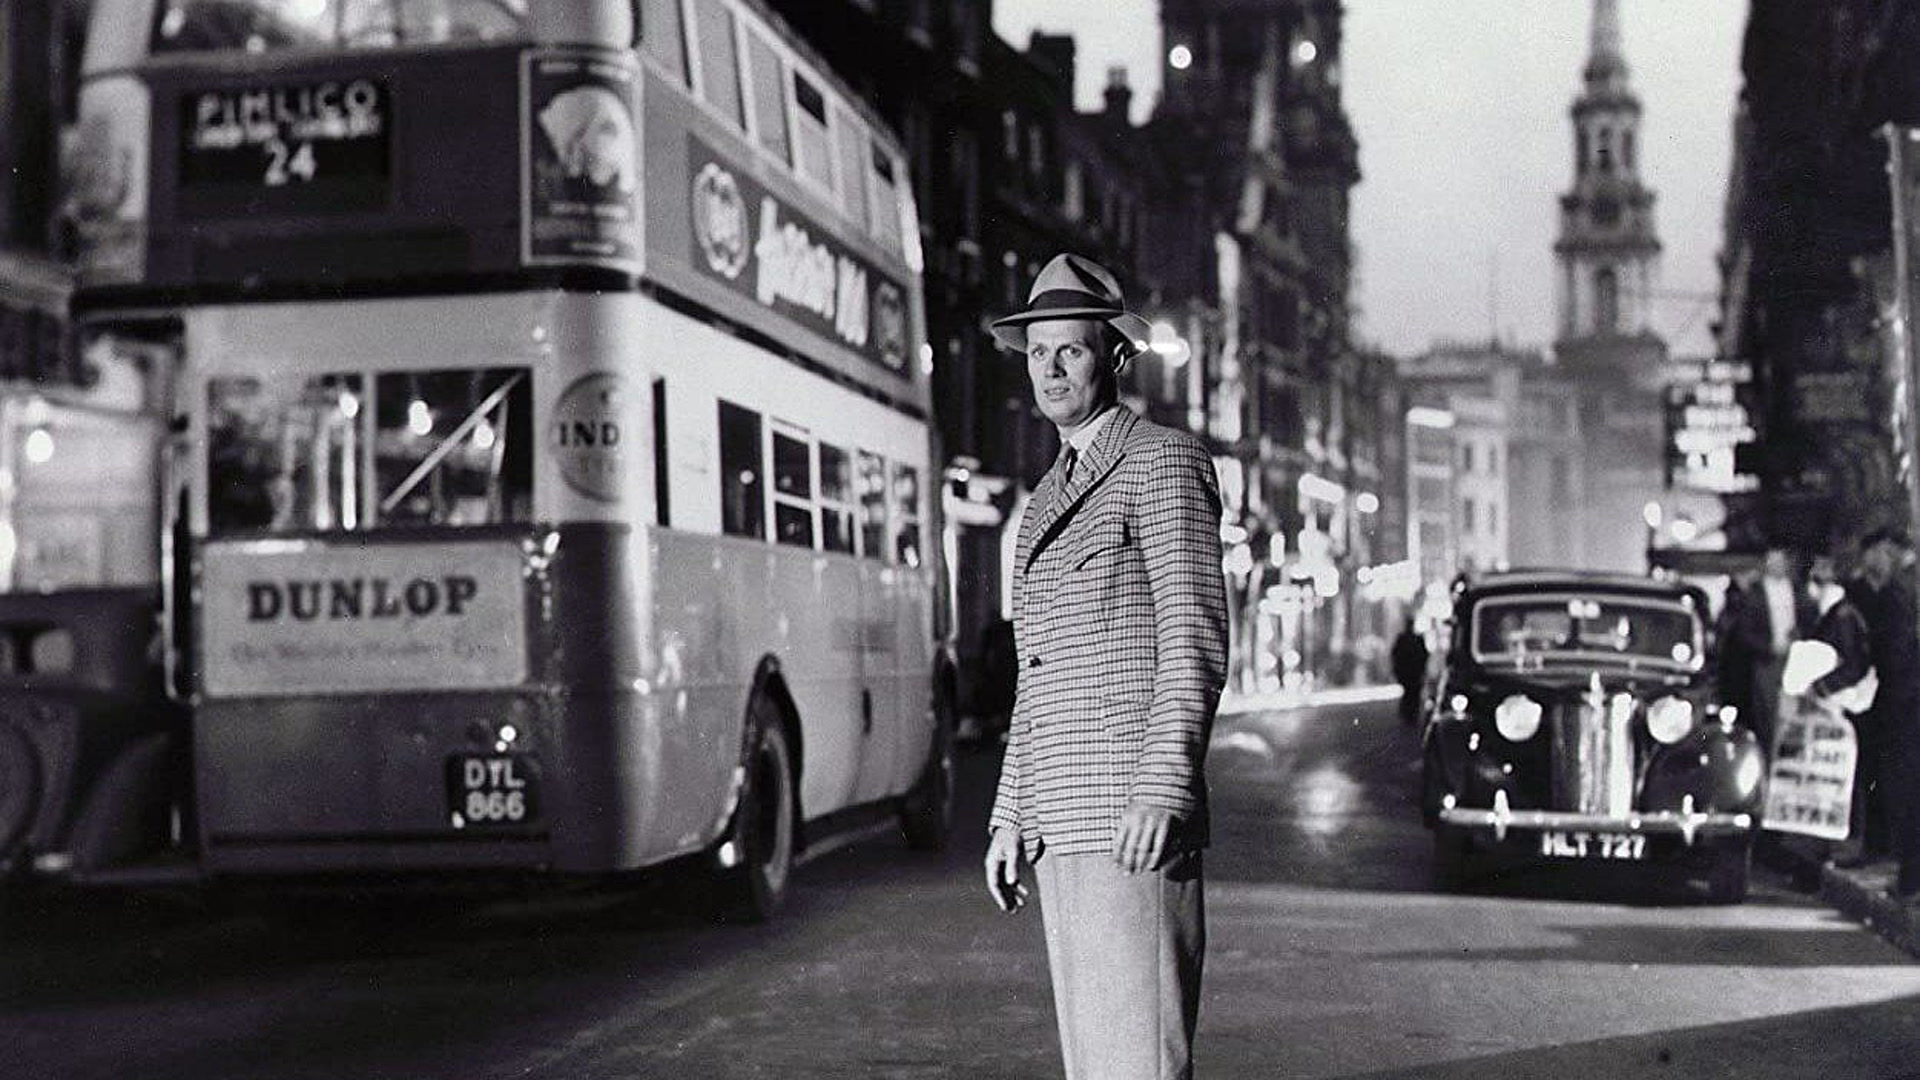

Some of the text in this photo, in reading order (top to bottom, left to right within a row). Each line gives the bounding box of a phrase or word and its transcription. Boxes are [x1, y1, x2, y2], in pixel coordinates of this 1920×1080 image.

[264, 138, 317, 186] 24
[559, 419, 619, 447] IND
[246, 574, 478, 623] DUNLOP
[466, 790, 525, 820] 866
[1599, 832, 1646, 859] 727
